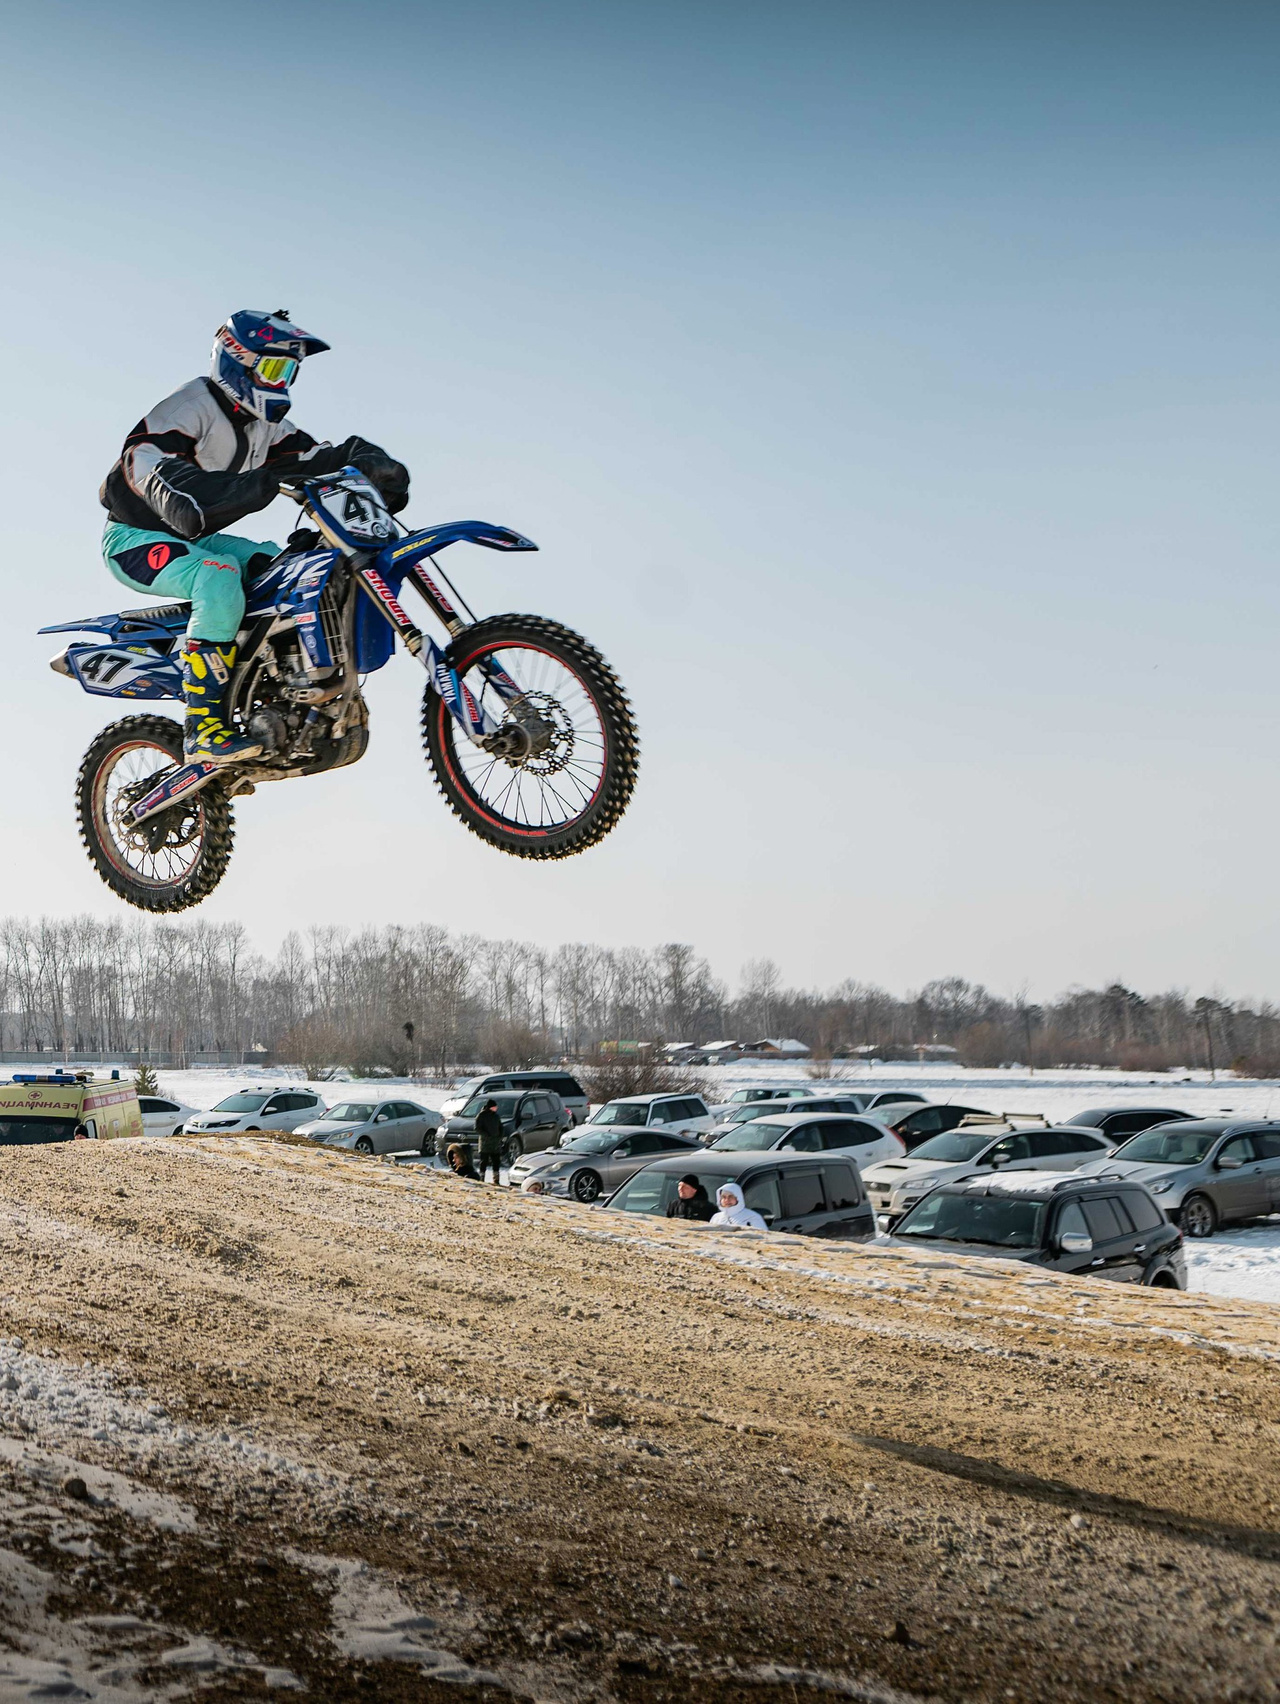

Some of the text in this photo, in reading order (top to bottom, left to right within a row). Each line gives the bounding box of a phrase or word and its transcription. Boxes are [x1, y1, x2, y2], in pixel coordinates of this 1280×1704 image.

[362, 569, 412, 627] SHOWA
[80, 652, 133, 685] 47
[436, 662, 457, 704] YAMAHA
